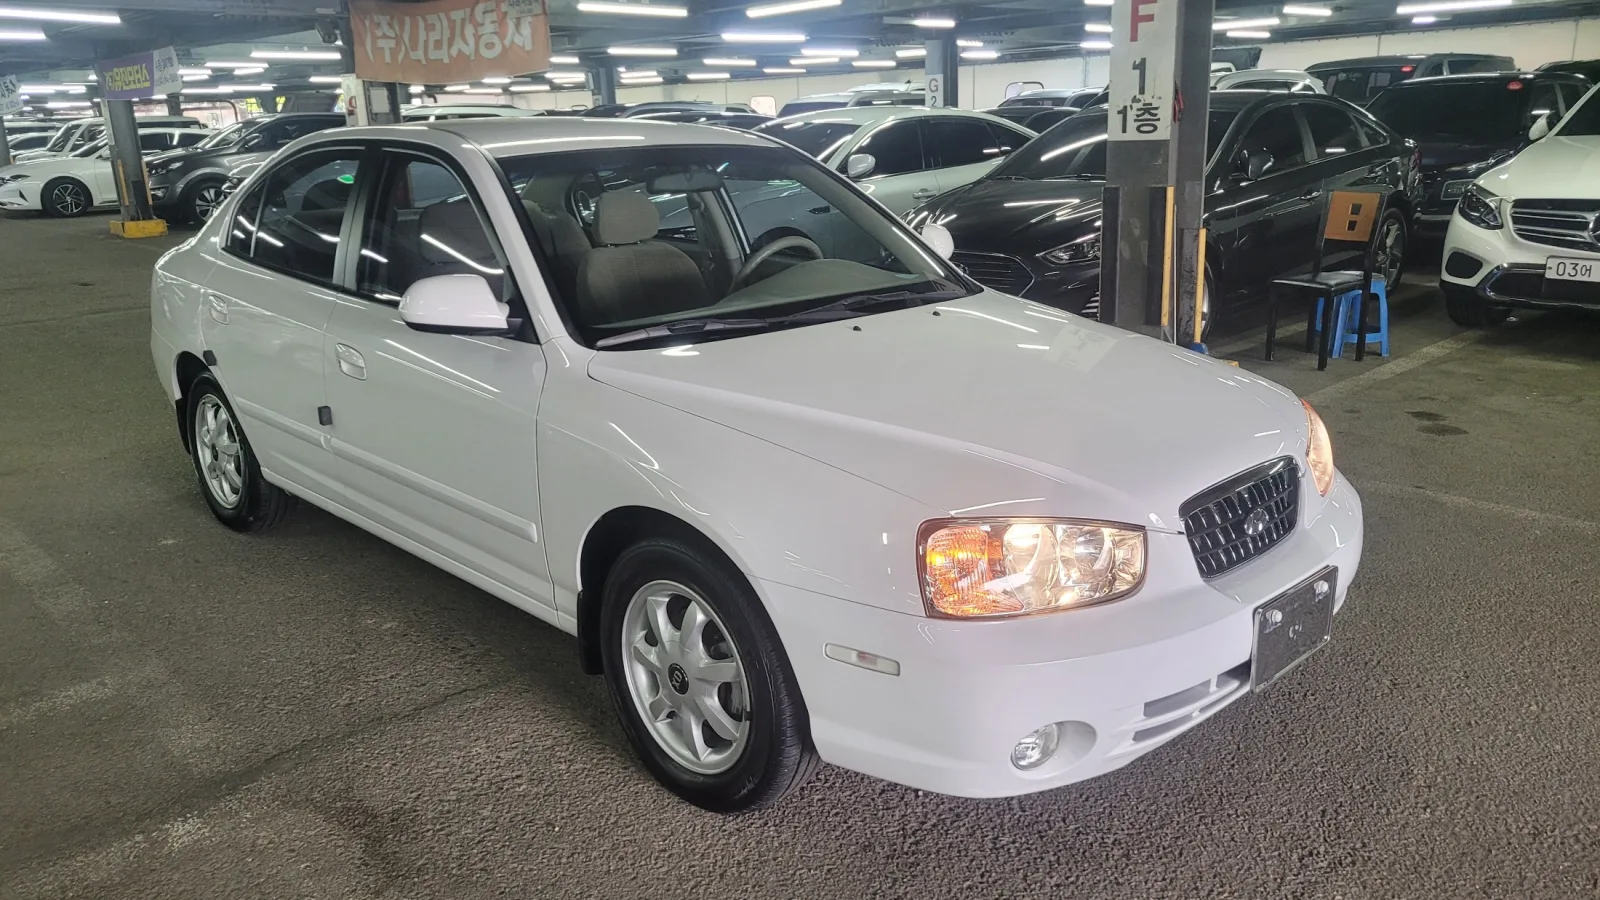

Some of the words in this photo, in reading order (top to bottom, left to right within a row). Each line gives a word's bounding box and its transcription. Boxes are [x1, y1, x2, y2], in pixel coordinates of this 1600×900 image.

[1129, 0, 1157, 42] F
[929, 78, 939, 93] G
[1132, 57, 1147, 95] 1
[930, 95, 937, 107] 2
[1117, 102, 1160, 134] 1층
[1556, 261, 1592, 278] 03어
